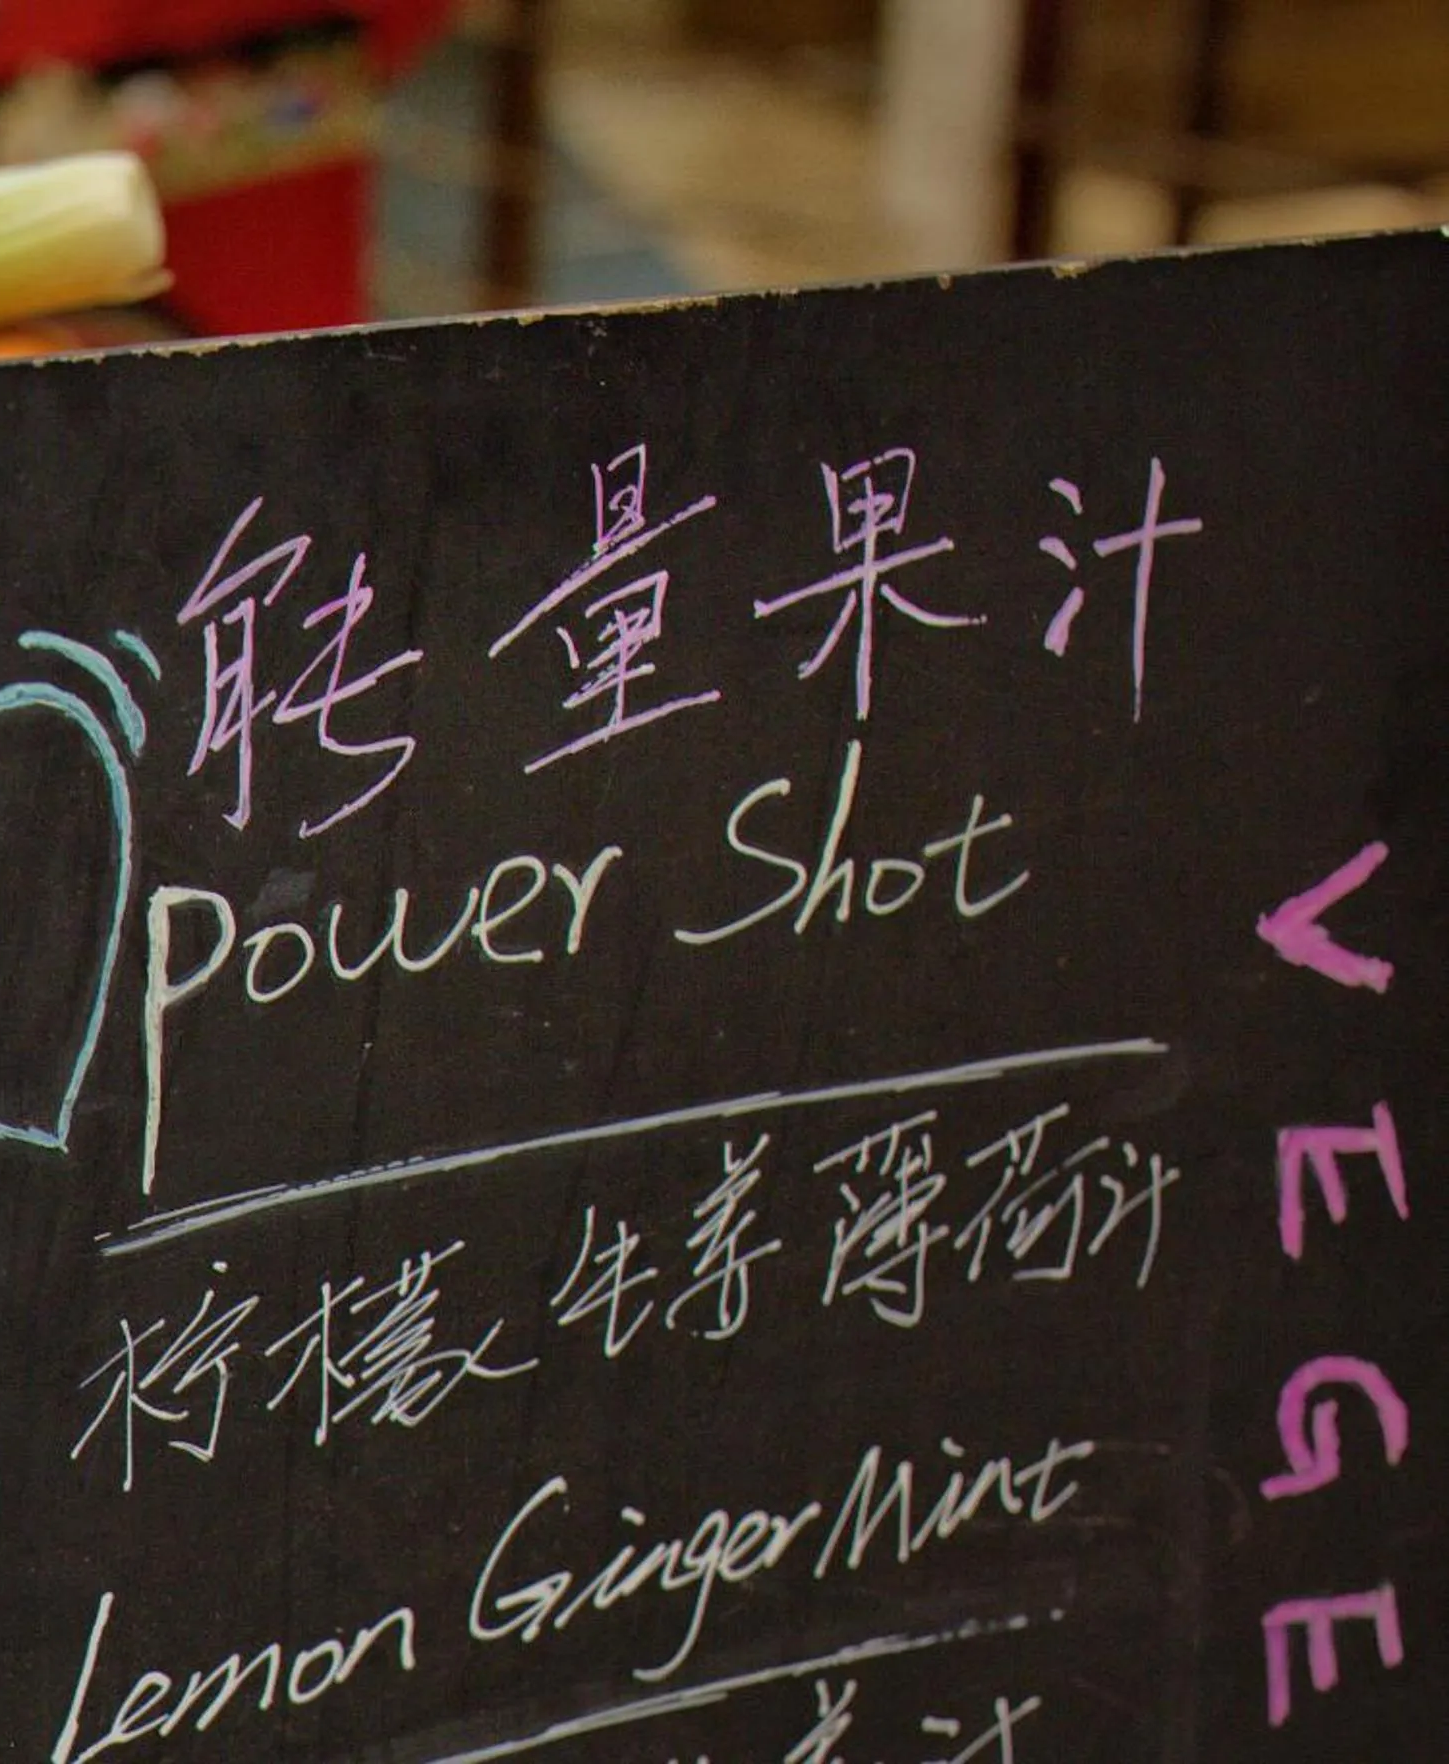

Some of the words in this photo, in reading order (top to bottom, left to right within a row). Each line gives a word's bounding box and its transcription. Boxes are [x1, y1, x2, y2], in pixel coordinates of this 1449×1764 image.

[176, 443, 1204, 839] 能量果汁
[673, 740, 1031, 945] Shot
[1256, 840, 1411, 1728] VEGE
